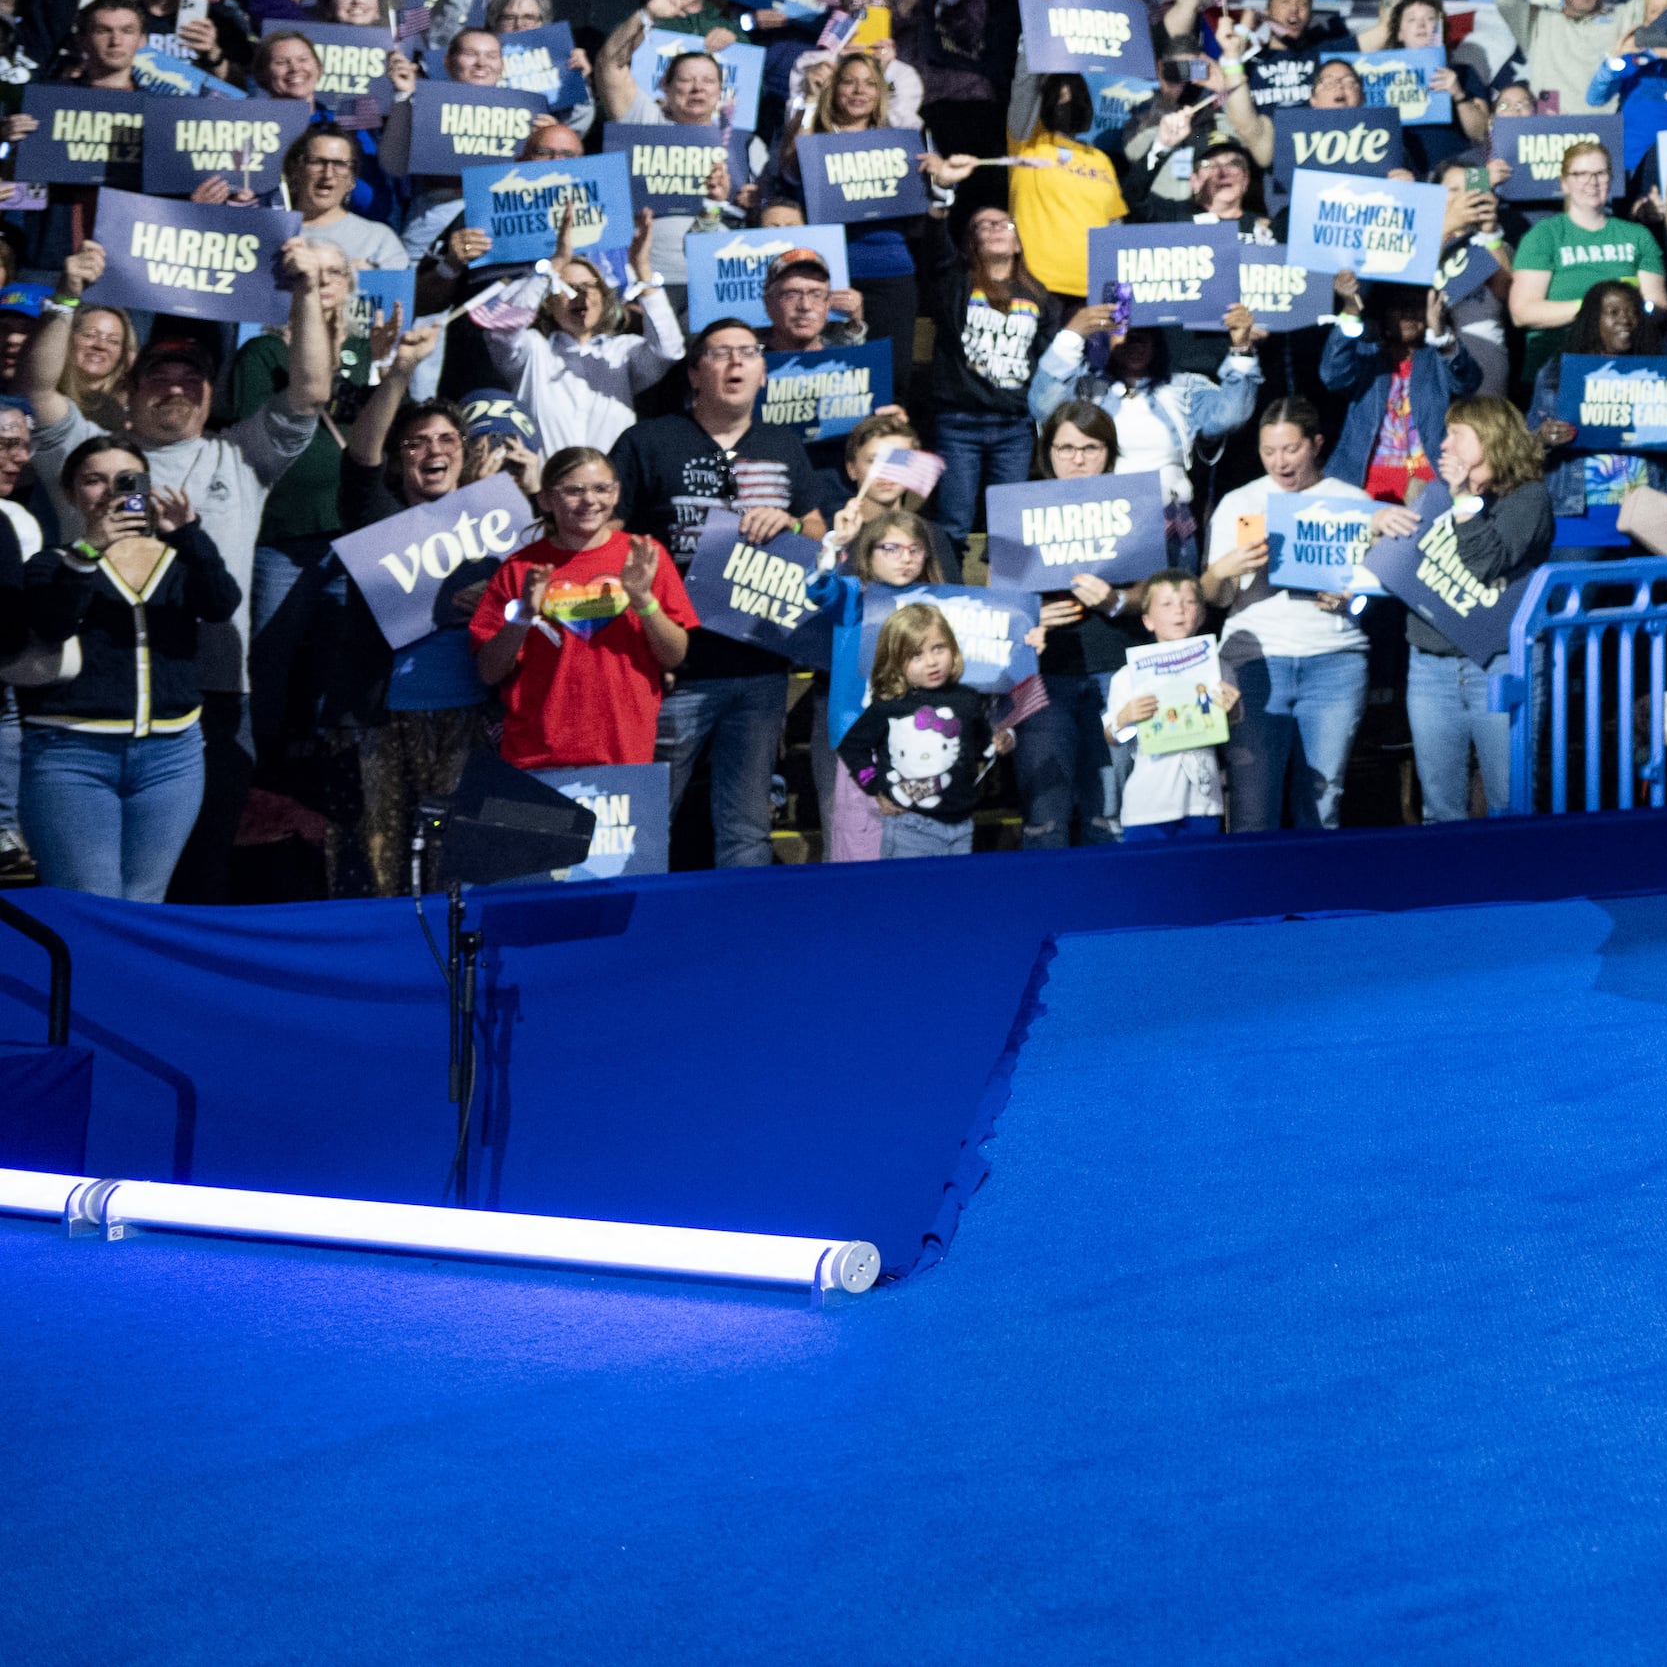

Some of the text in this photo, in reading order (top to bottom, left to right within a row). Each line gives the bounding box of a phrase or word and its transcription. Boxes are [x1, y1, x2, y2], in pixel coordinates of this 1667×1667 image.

[1048, 7, 1131, 42] HARRIS
[314, 43, 386, 78] ARRIS
[1063, 35, 1122, 57] WALZ
[52, 109, 144, 143] HARRI
[175, 120, 281, 154] HARRIS
[440, 103, 533, 141] HARRIS
[452, 135, 517, 157] WALZ
[1292, 122, 1391, 165] vote
[824, 147, 908, 185] HARRIS
[491, 179, 598, 215] MICHIGAN
[841, 179, 898, 202] WALZ
[491, 212, 548, 237] VOTES
[1317, 200, 1415, 232] MICHIGAN
[130, 221, 260, 273] HARRIS
[1312, 225, 1417, 255] VOTES EARLY
[1557, 241, 1637, 267] HARRIS
[146, 260, 237, 295] WALZ
[717, 256, 772, 281] MICH
[1117, 245, 1215, 283] HARRIS
[1132, 279, 1202, 303] WALZ
[766, 367, 870, 403] MICHIGAN
[761, 392, 873, 425] VOTES EARLY
[1579, 402, 1631, 427] VOTES
[1021, 499, 1132, 546] HARRIS
[1297, 520, 1371, 543] MICHIG
[378, 506, 518, 595] vote
[1039, 537, 1118, 566] WALZ
[1293, 543, 1344, 566] VOTES
[1416, 558, 1479, 618] WALZ
[730, 585, 803, 631] WALZ
